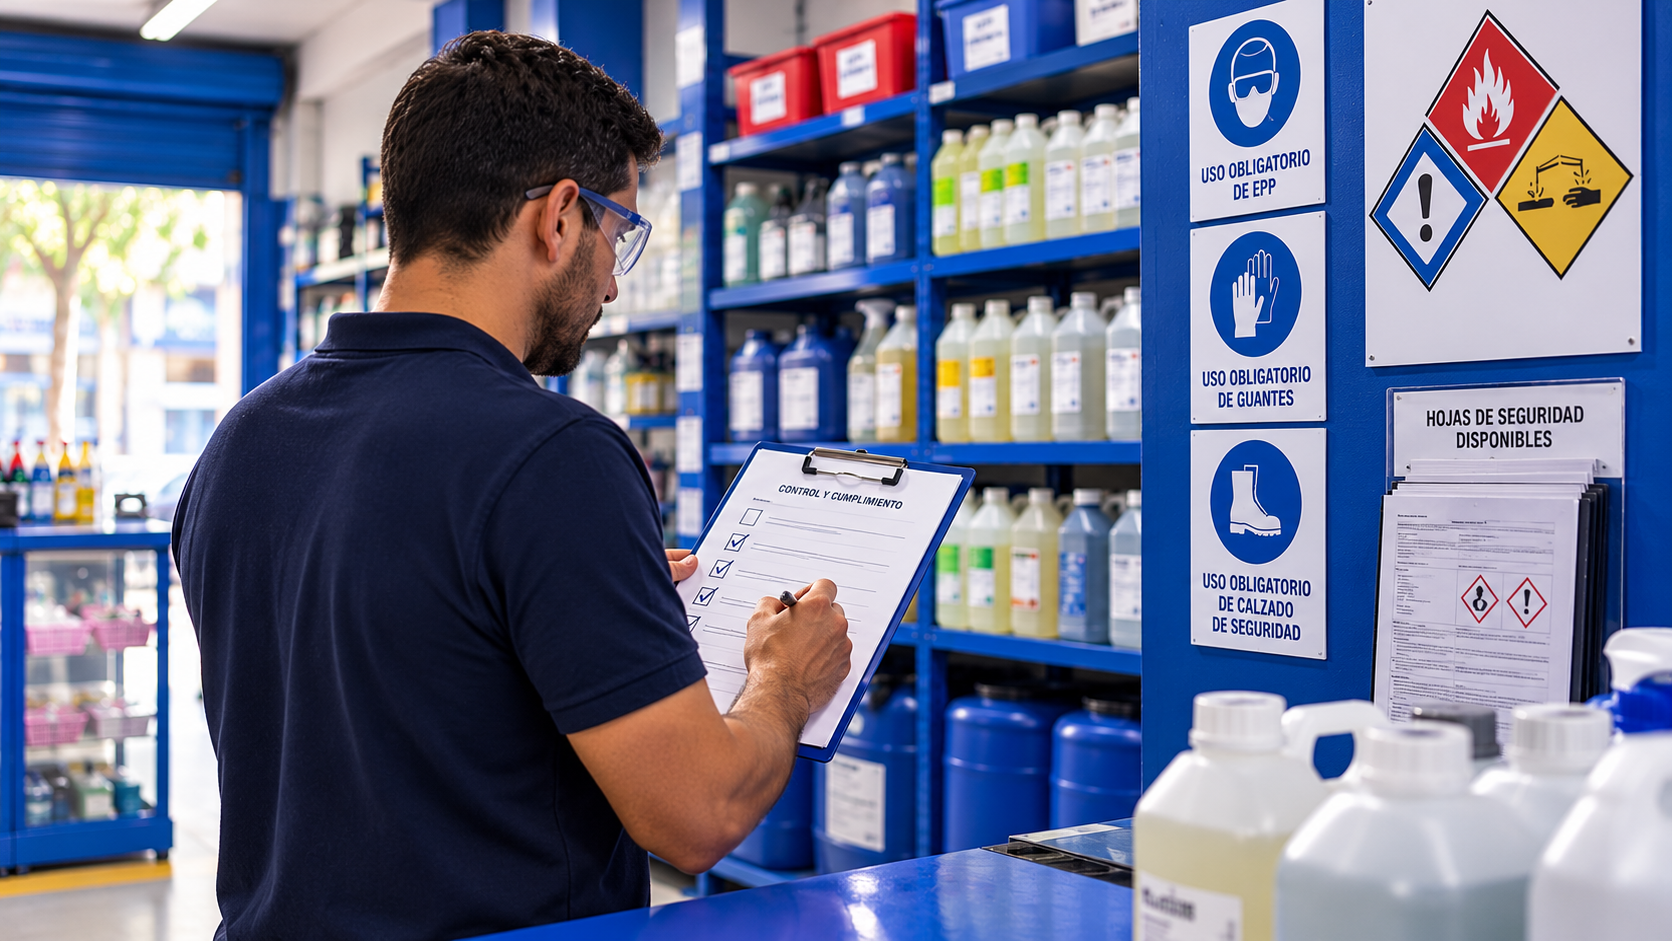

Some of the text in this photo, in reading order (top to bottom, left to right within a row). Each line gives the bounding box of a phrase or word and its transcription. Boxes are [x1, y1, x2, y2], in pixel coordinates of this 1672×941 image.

[1201, 148, 1311, 184] USO OBLIGATORIO
[1233, 177, 1277, 201] DE EPP
[1202, 365, 1311, 387] USO OBLIGATORIO
[1218, 389, 1294, 409] DE GUANTES
[1426, 405, 1584, 427] HOJAS DE SEGURIDAD
[1456, 429, 1553, 449] DISPONIBLES
[778, 484, 903, 510] CONTROL Y CUMPLIMIENTO
[1202, 572, 1311, 597] USO OBLIGATORIO
[1218, 595, 1294, 619] DE CALZADO
[1212, 616, 1301, 641] DE SEGURIDAD
